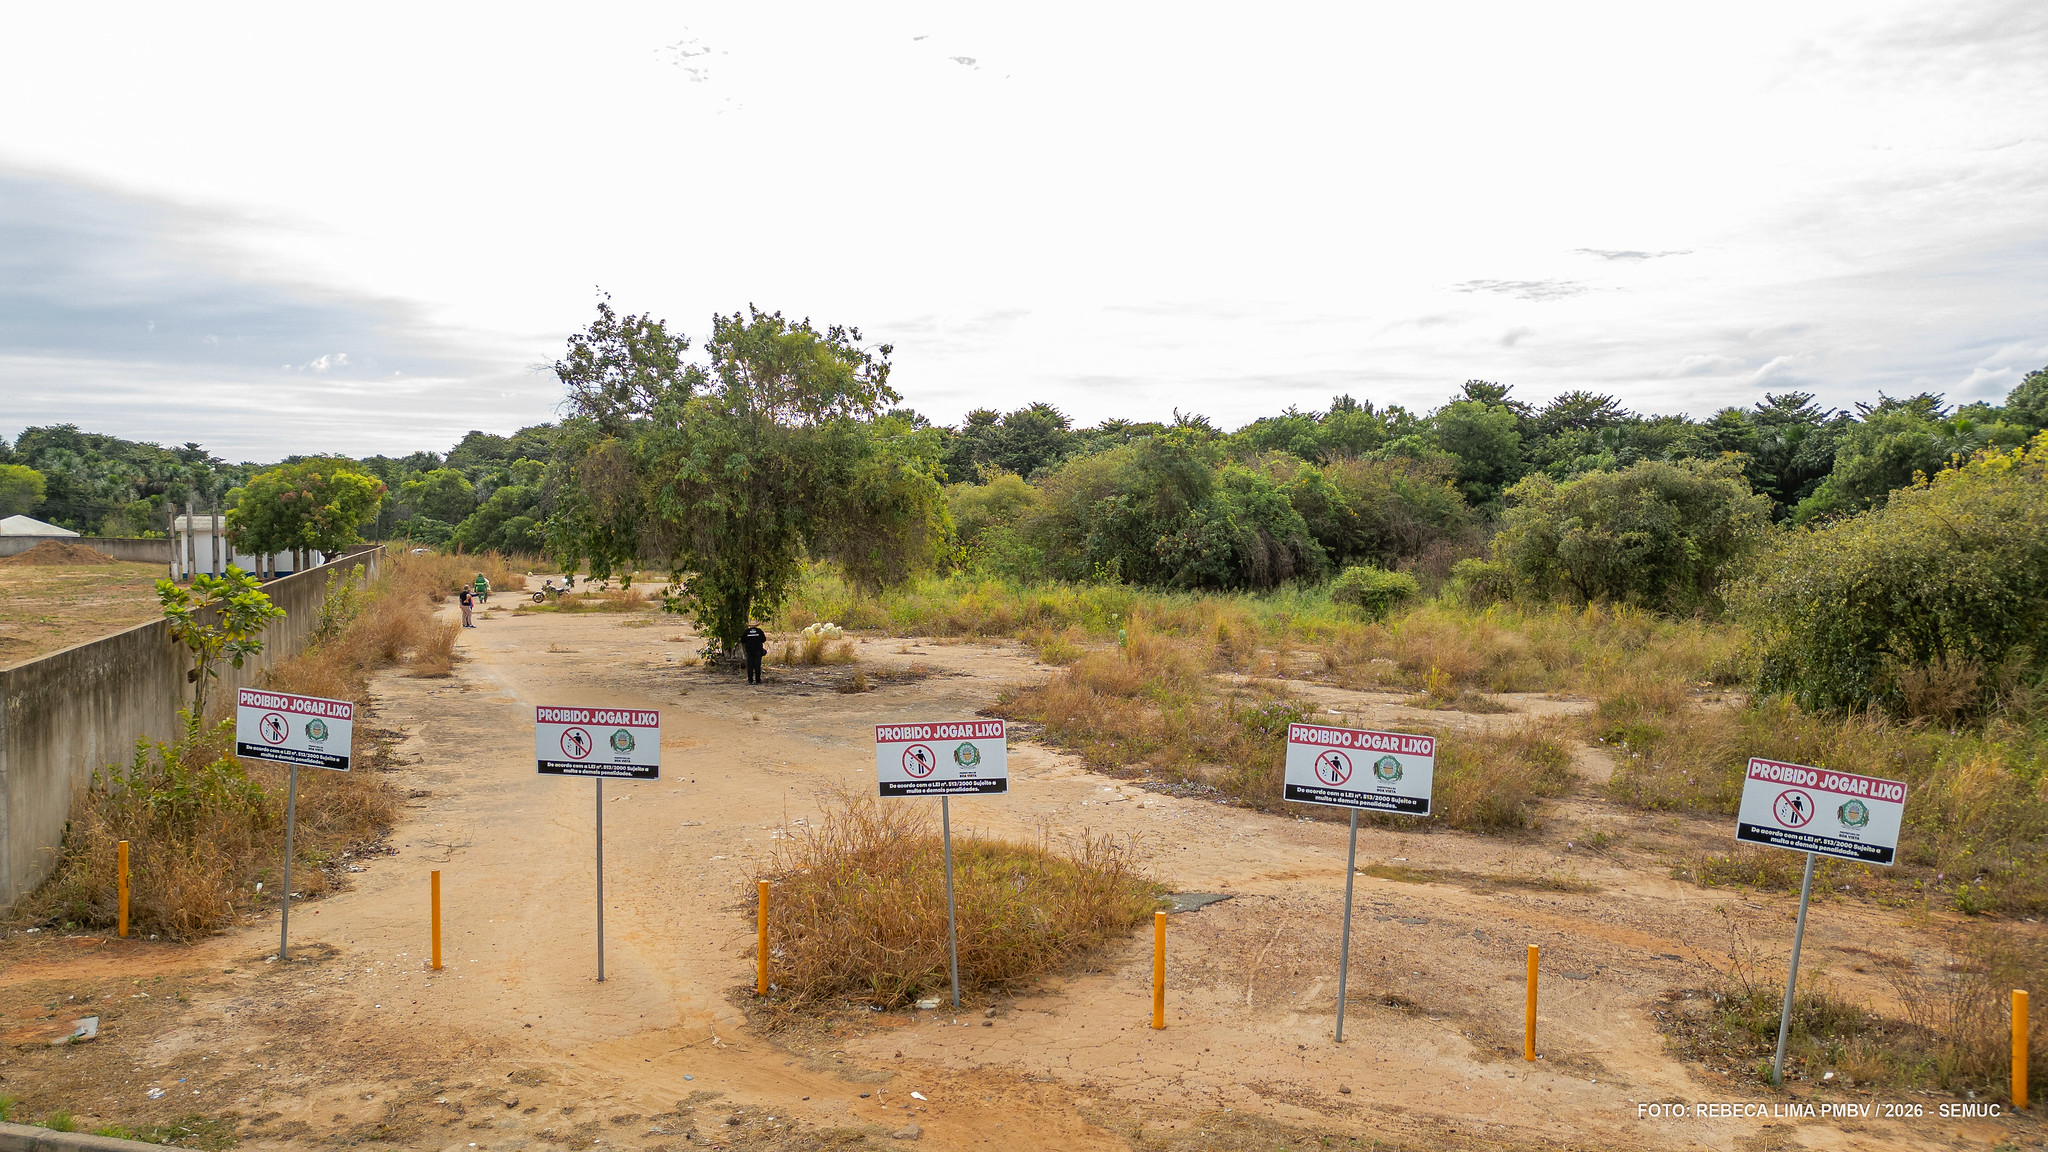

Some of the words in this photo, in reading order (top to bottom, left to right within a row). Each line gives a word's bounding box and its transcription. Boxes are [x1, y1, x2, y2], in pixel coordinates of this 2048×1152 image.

[241, 692, 288, 709] PROIBIDO
[290, 699, 325, 714] JOGAR
[327, 704, 350, 717] LIXO
[538, 709, 589, 722] PROIBIDO
[592, 711, 630, 724] JOGAR
[632, 713, 657, 725] LIXO
[878, 726, 931, 740] PROIBIDO
[934, 724, 973, 738] JOGAR
[975, 723, 1001, 736] LIXO
[1292, 728, 1351, 745] PROIBIDO
[1354, 734, 1399, 750] JOGAR
[1402, 738, 1431, 754] LIXO
[1752, 763, 1817, 785] PROIBIDO
[1820, 775, 1868, 794] JOGAR
[1870, 782, 1902, 800] LIXO
[1795, 841, 1818, 849] demais
[1853, 844, 1875, 852] Sujeito
